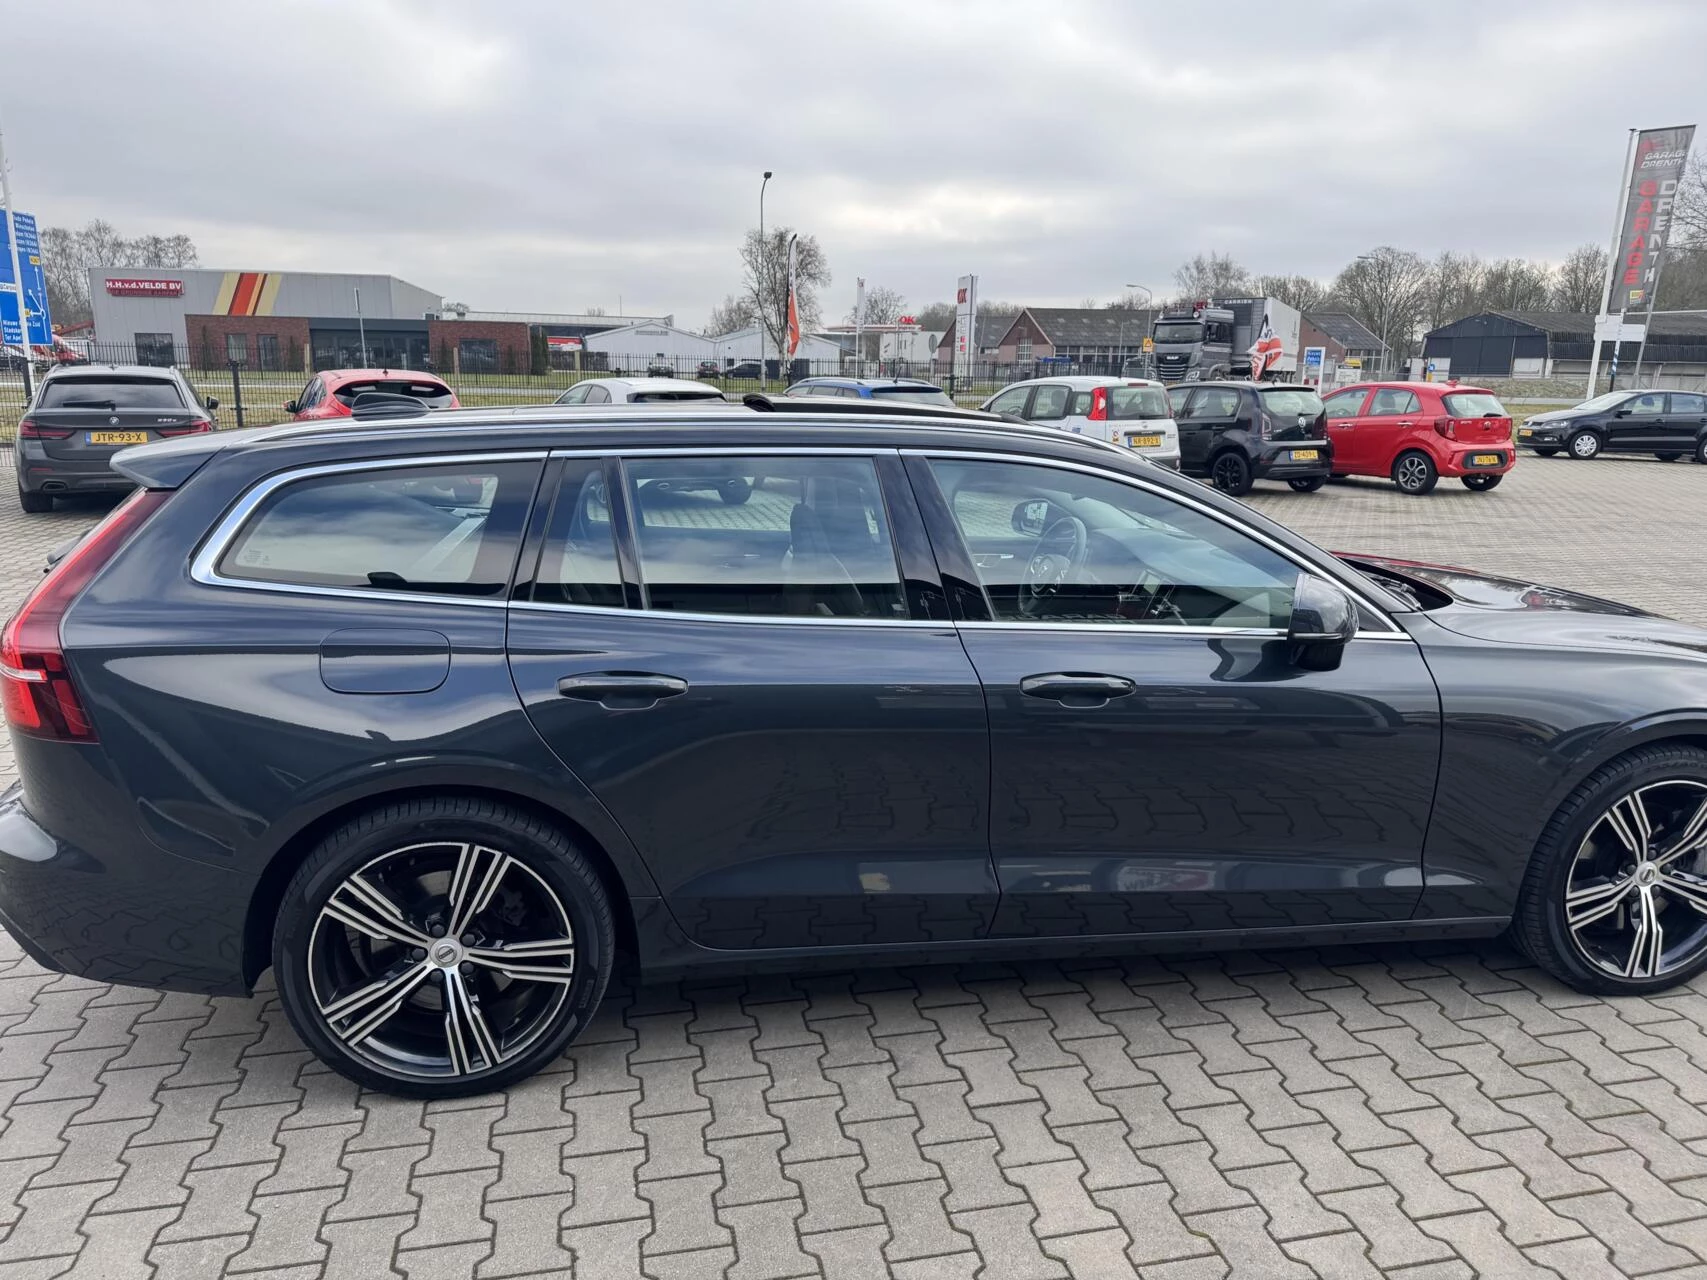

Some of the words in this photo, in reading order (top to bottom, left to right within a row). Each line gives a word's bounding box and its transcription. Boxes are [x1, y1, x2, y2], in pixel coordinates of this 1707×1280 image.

[1623, 180, 1658, 286] GARAGE
[106, 281, 167, 290] H.H.v.d.VELDE
[169, 282, 182, 290] BV
[95, 433, 143, 442] JTR-93-X
